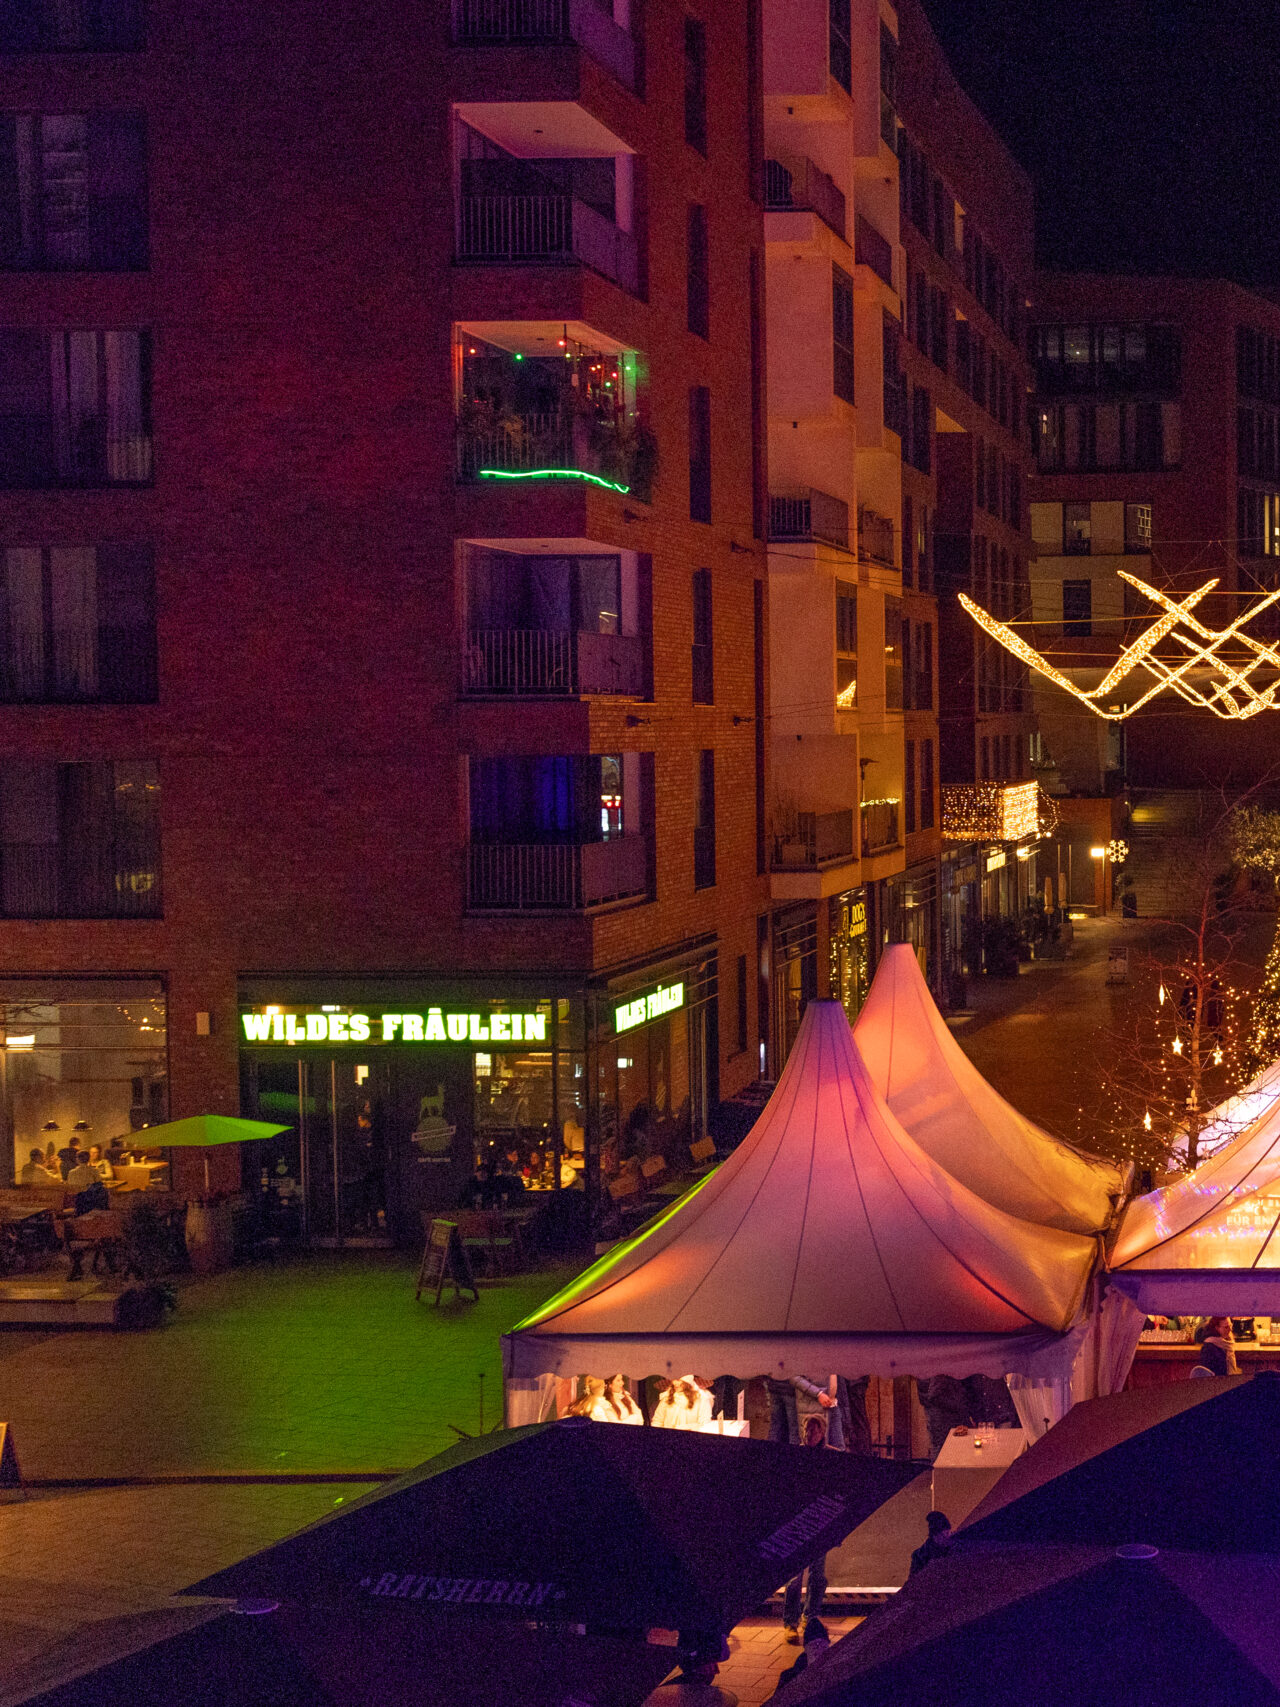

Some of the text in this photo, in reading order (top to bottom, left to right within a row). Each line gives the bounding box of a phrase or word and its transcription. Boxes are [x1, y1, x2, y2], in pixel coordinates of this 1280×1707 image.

[241, 1007, 548, 1042] WILDES FRÄULEIN
[615, 996, 647, 1034] WILDES
[1226, 1213, 1250, 1226] FÜR
[369, 1571, 555, 1605] RATSHERRN
